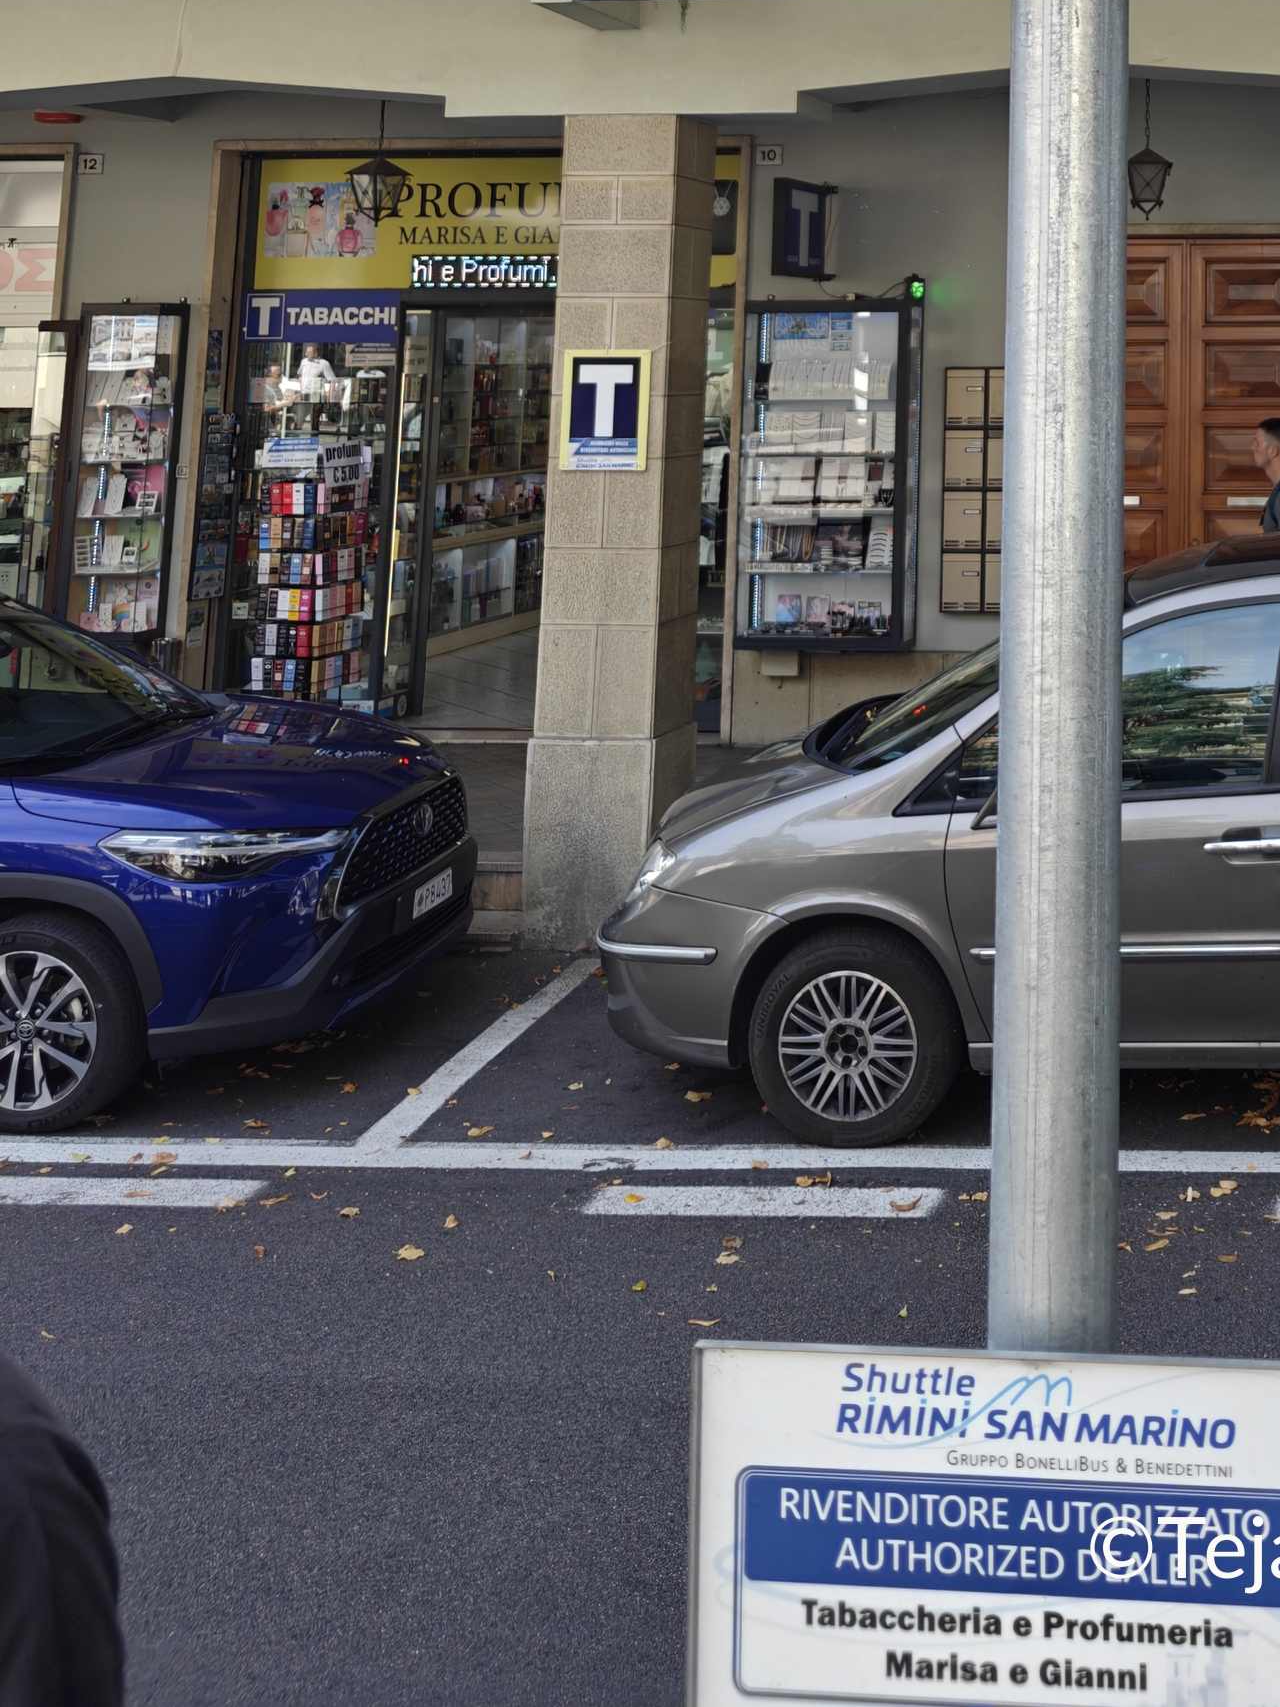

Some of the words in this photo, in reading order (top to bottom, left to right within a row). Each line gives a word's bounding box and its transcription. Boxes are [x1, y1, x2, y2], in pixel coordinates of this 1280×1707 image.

[83, 158, 97, 170] 12
[761, 150, 777, 162] 10
[386, 182, 562, 218] PROFU
[398, 226, 486, 245] MARISA
[495, 226, 508, 245] E
[514, 225, 560, 245] GIA
[442, 264, 455, 282] e
[251, 297, 281, 336] T
[287, 307, 397, 326] TABACCHI
[579, 364, 634, 438] T
[325, 441, 363, 463] profumi
[755, 972, 794, 1039] UNIROYAL
[842, 1362, 976, 1397] Shuttle
[984, 1408, 1068, 1442] SAN
[1116, 1459, 1127, 1474] &
[780, 1487, 1009, 1530] RIVENDITORE
[835, 1537, 1065, 1580] AUTHORIZED
[801, 1598, 1002, 1636] Tabaccheria
[1013, 1615, 1033, 1637] e
[1043, 1611, 1233, 1649] Profumeria
[885, 1650, 999, 1683] Marisa
[1009, 1662, 1029, 1685] e
[1040, 1657, 1148, 1692] Gianni
